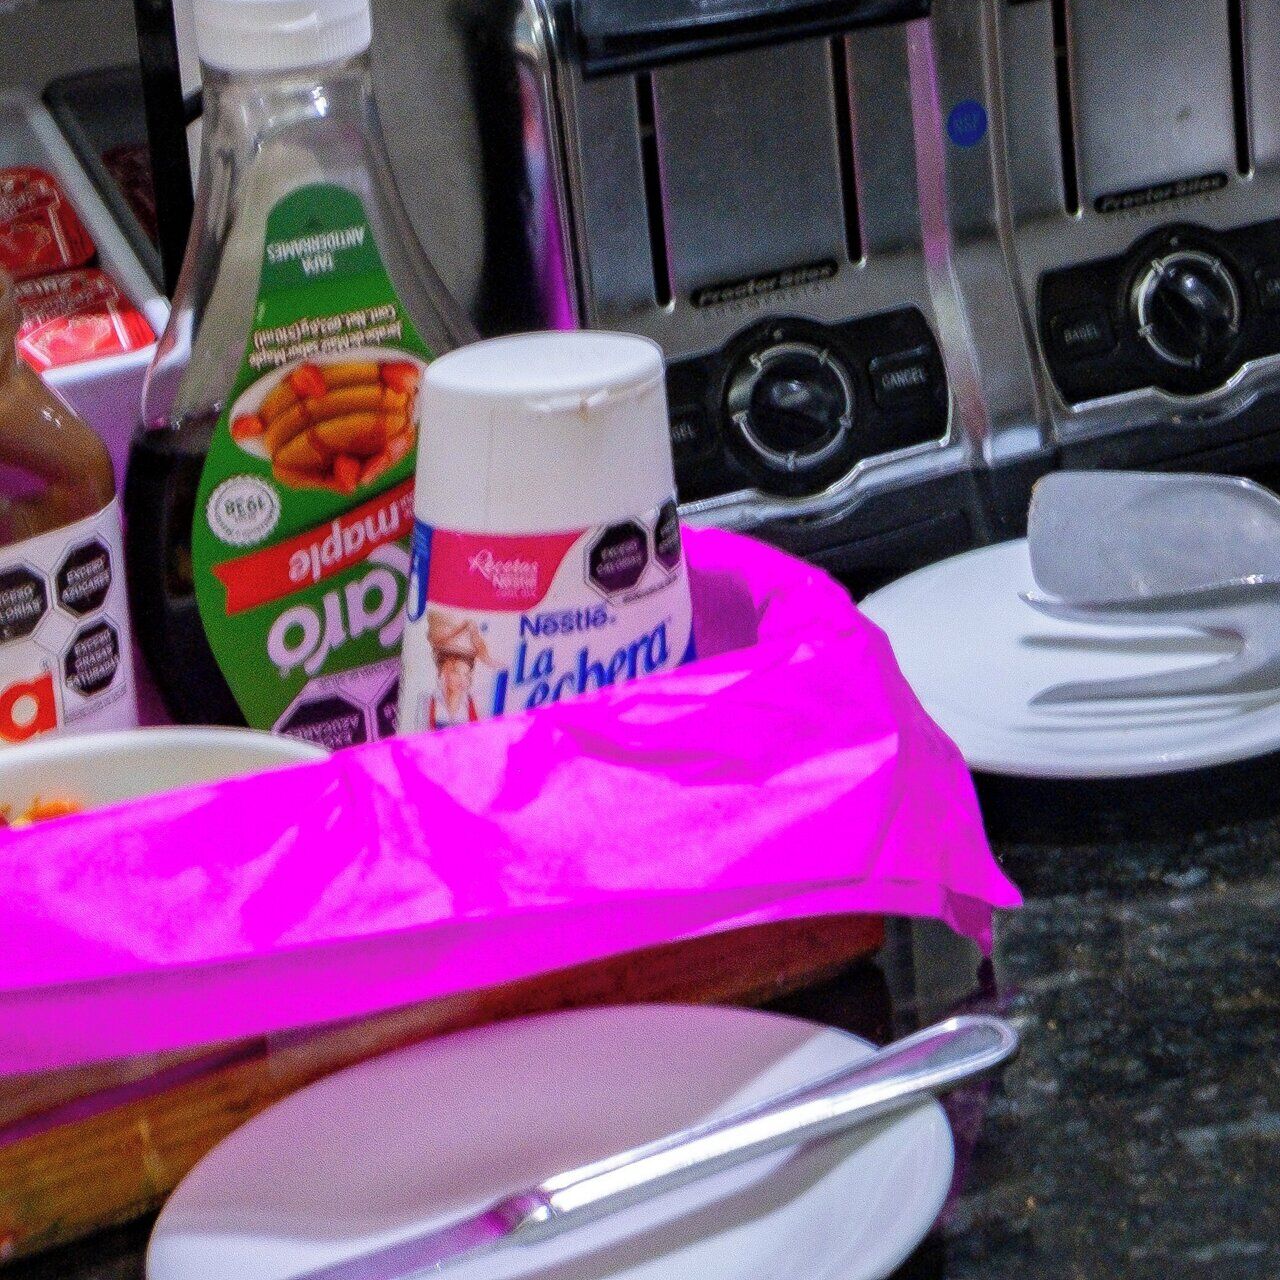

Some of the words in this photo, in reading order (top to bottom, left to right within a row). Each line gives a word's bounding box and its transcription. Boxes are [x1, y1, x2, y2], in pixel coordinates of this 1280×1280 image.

[881, 367, 926, 391] CANCEL
[288, 502, 401, 584] maple
[515, 642, 554, 685] La
